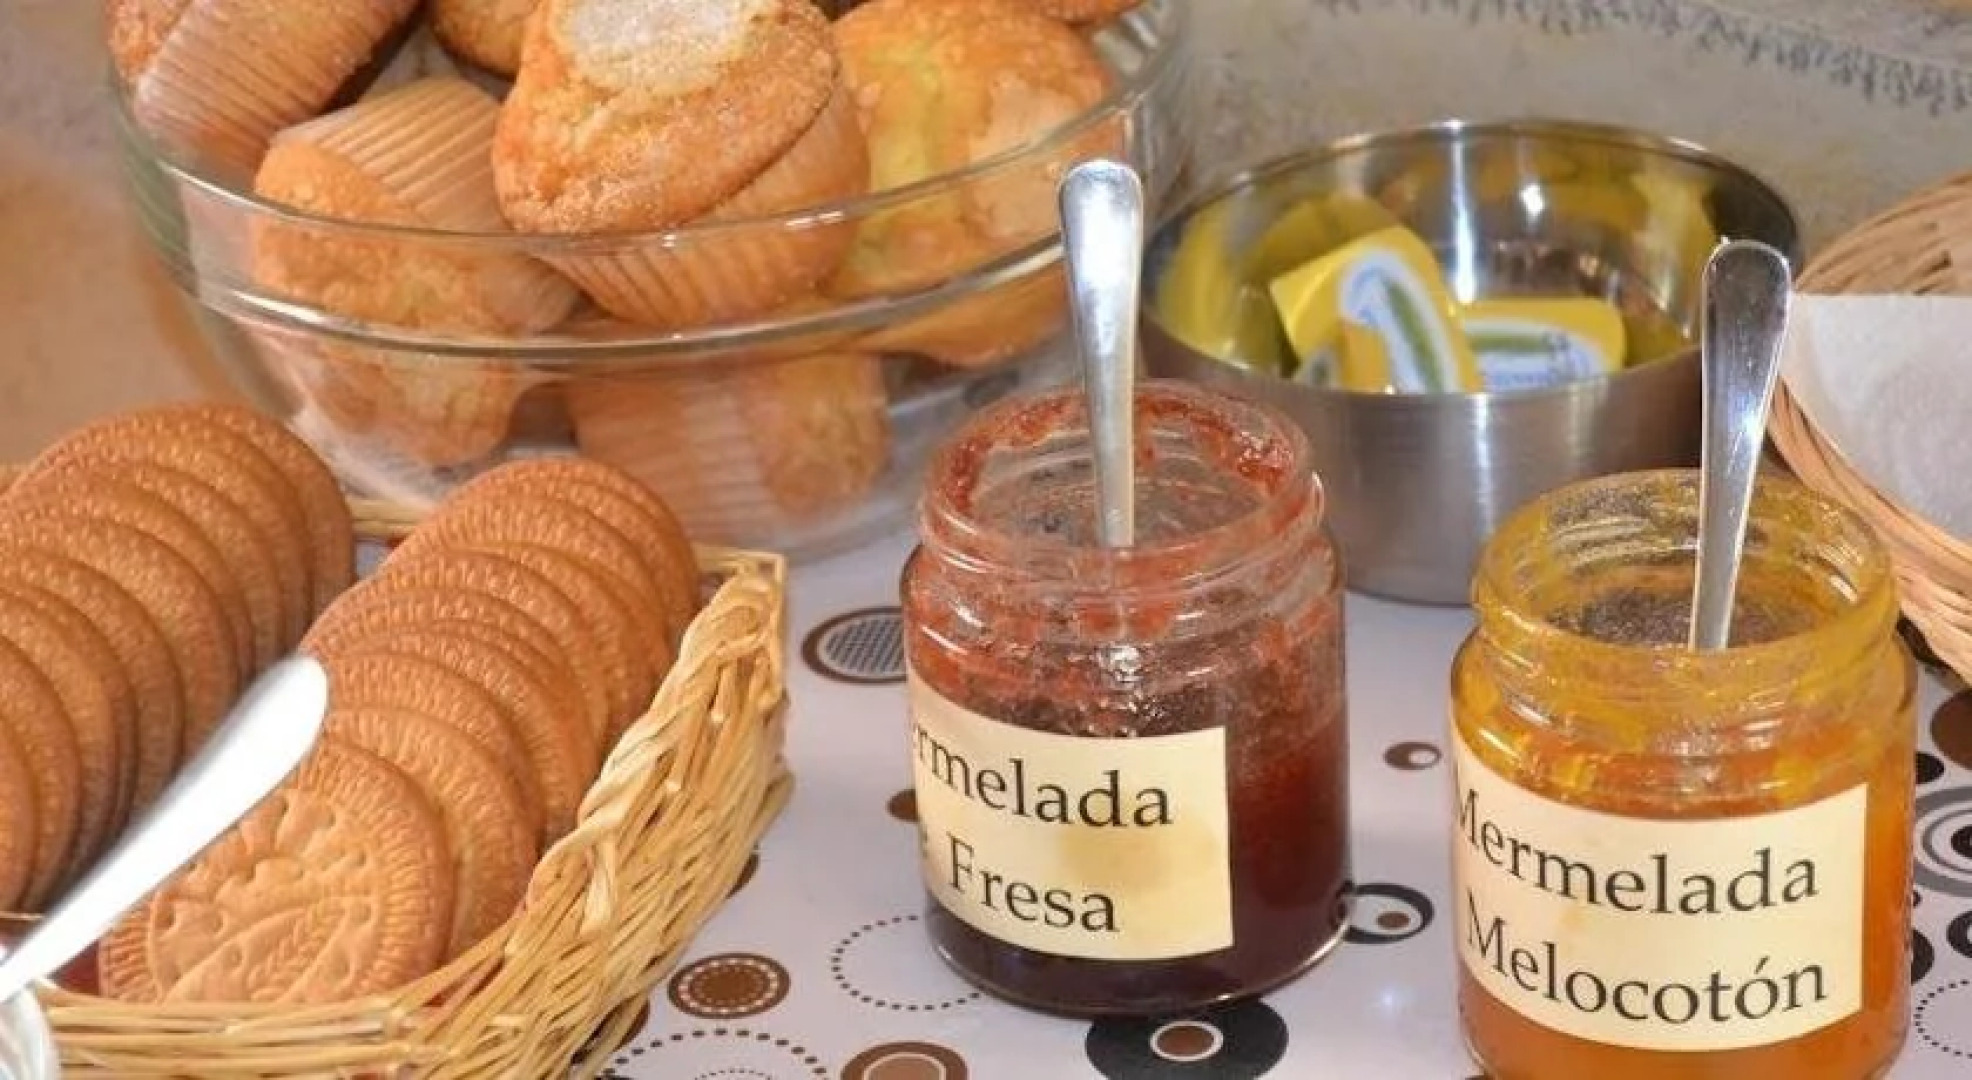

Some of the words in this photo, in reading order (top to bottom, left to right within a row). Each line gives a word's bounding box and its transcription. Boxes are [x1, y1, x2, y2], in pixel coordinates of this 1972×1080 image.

[915, 724, 1174, 828] rmelada
[946, 831, 1120, 933] Fresa
[1466, 885, 1828, 1025] Melocotón
